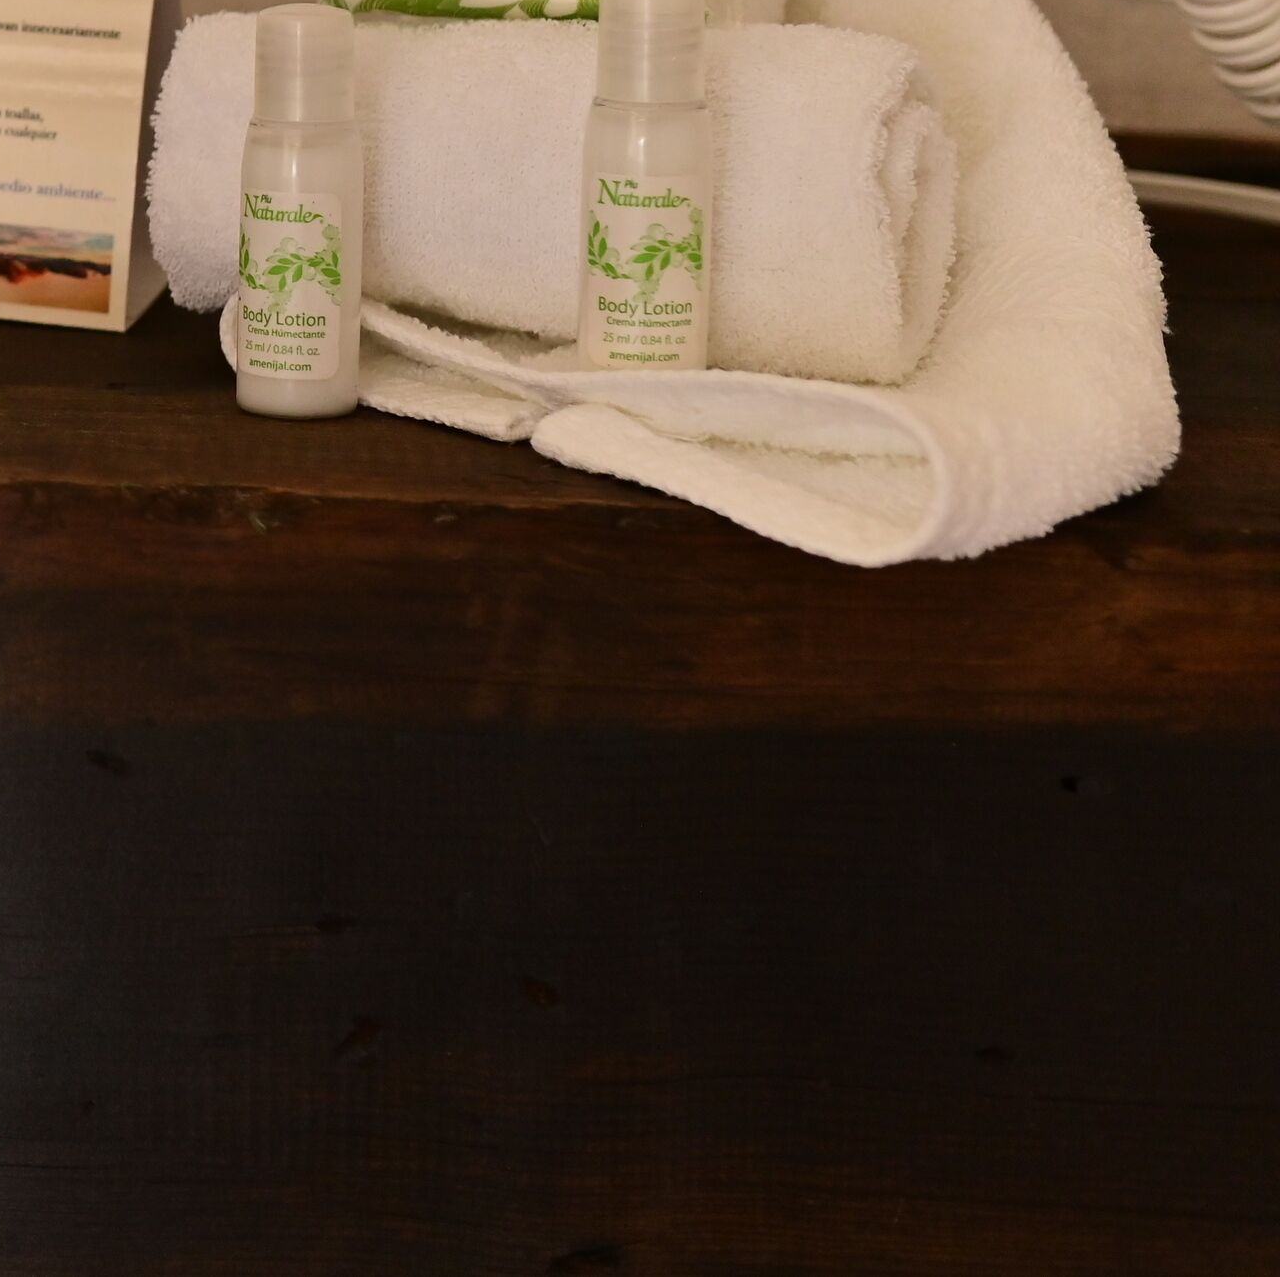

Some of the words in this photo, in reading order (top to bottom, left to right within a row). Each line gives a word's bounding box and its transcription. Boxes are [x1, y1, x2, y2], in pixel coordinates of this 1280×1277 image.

[21, 20, 121, 38] innecesariamente
[3, 124, 57, 141] cualquier
[598, 178, 690, 208] Naturale
[244, 193, 323, 223] Naturale
[598, 296, 639, 318] Body
[644, 301, 692, 315] Lotion
[243, 305, 272, 327] Body
[276, 311, 326, 327] Lotion
[607, 316, 636, 327] Crema
[248, 324, 269, 336] Crema
[603, 332, 614, 343] 25
[617, 334, 630, 343] ml
[641, 335, 662, 345] 0.84
[254, 342, 265, 352] ml
[273, 344, 293, 355] 0.84
[249, 358, 312, 372] amenijal.com
[609, 351, 680, 364] amenijal.com
